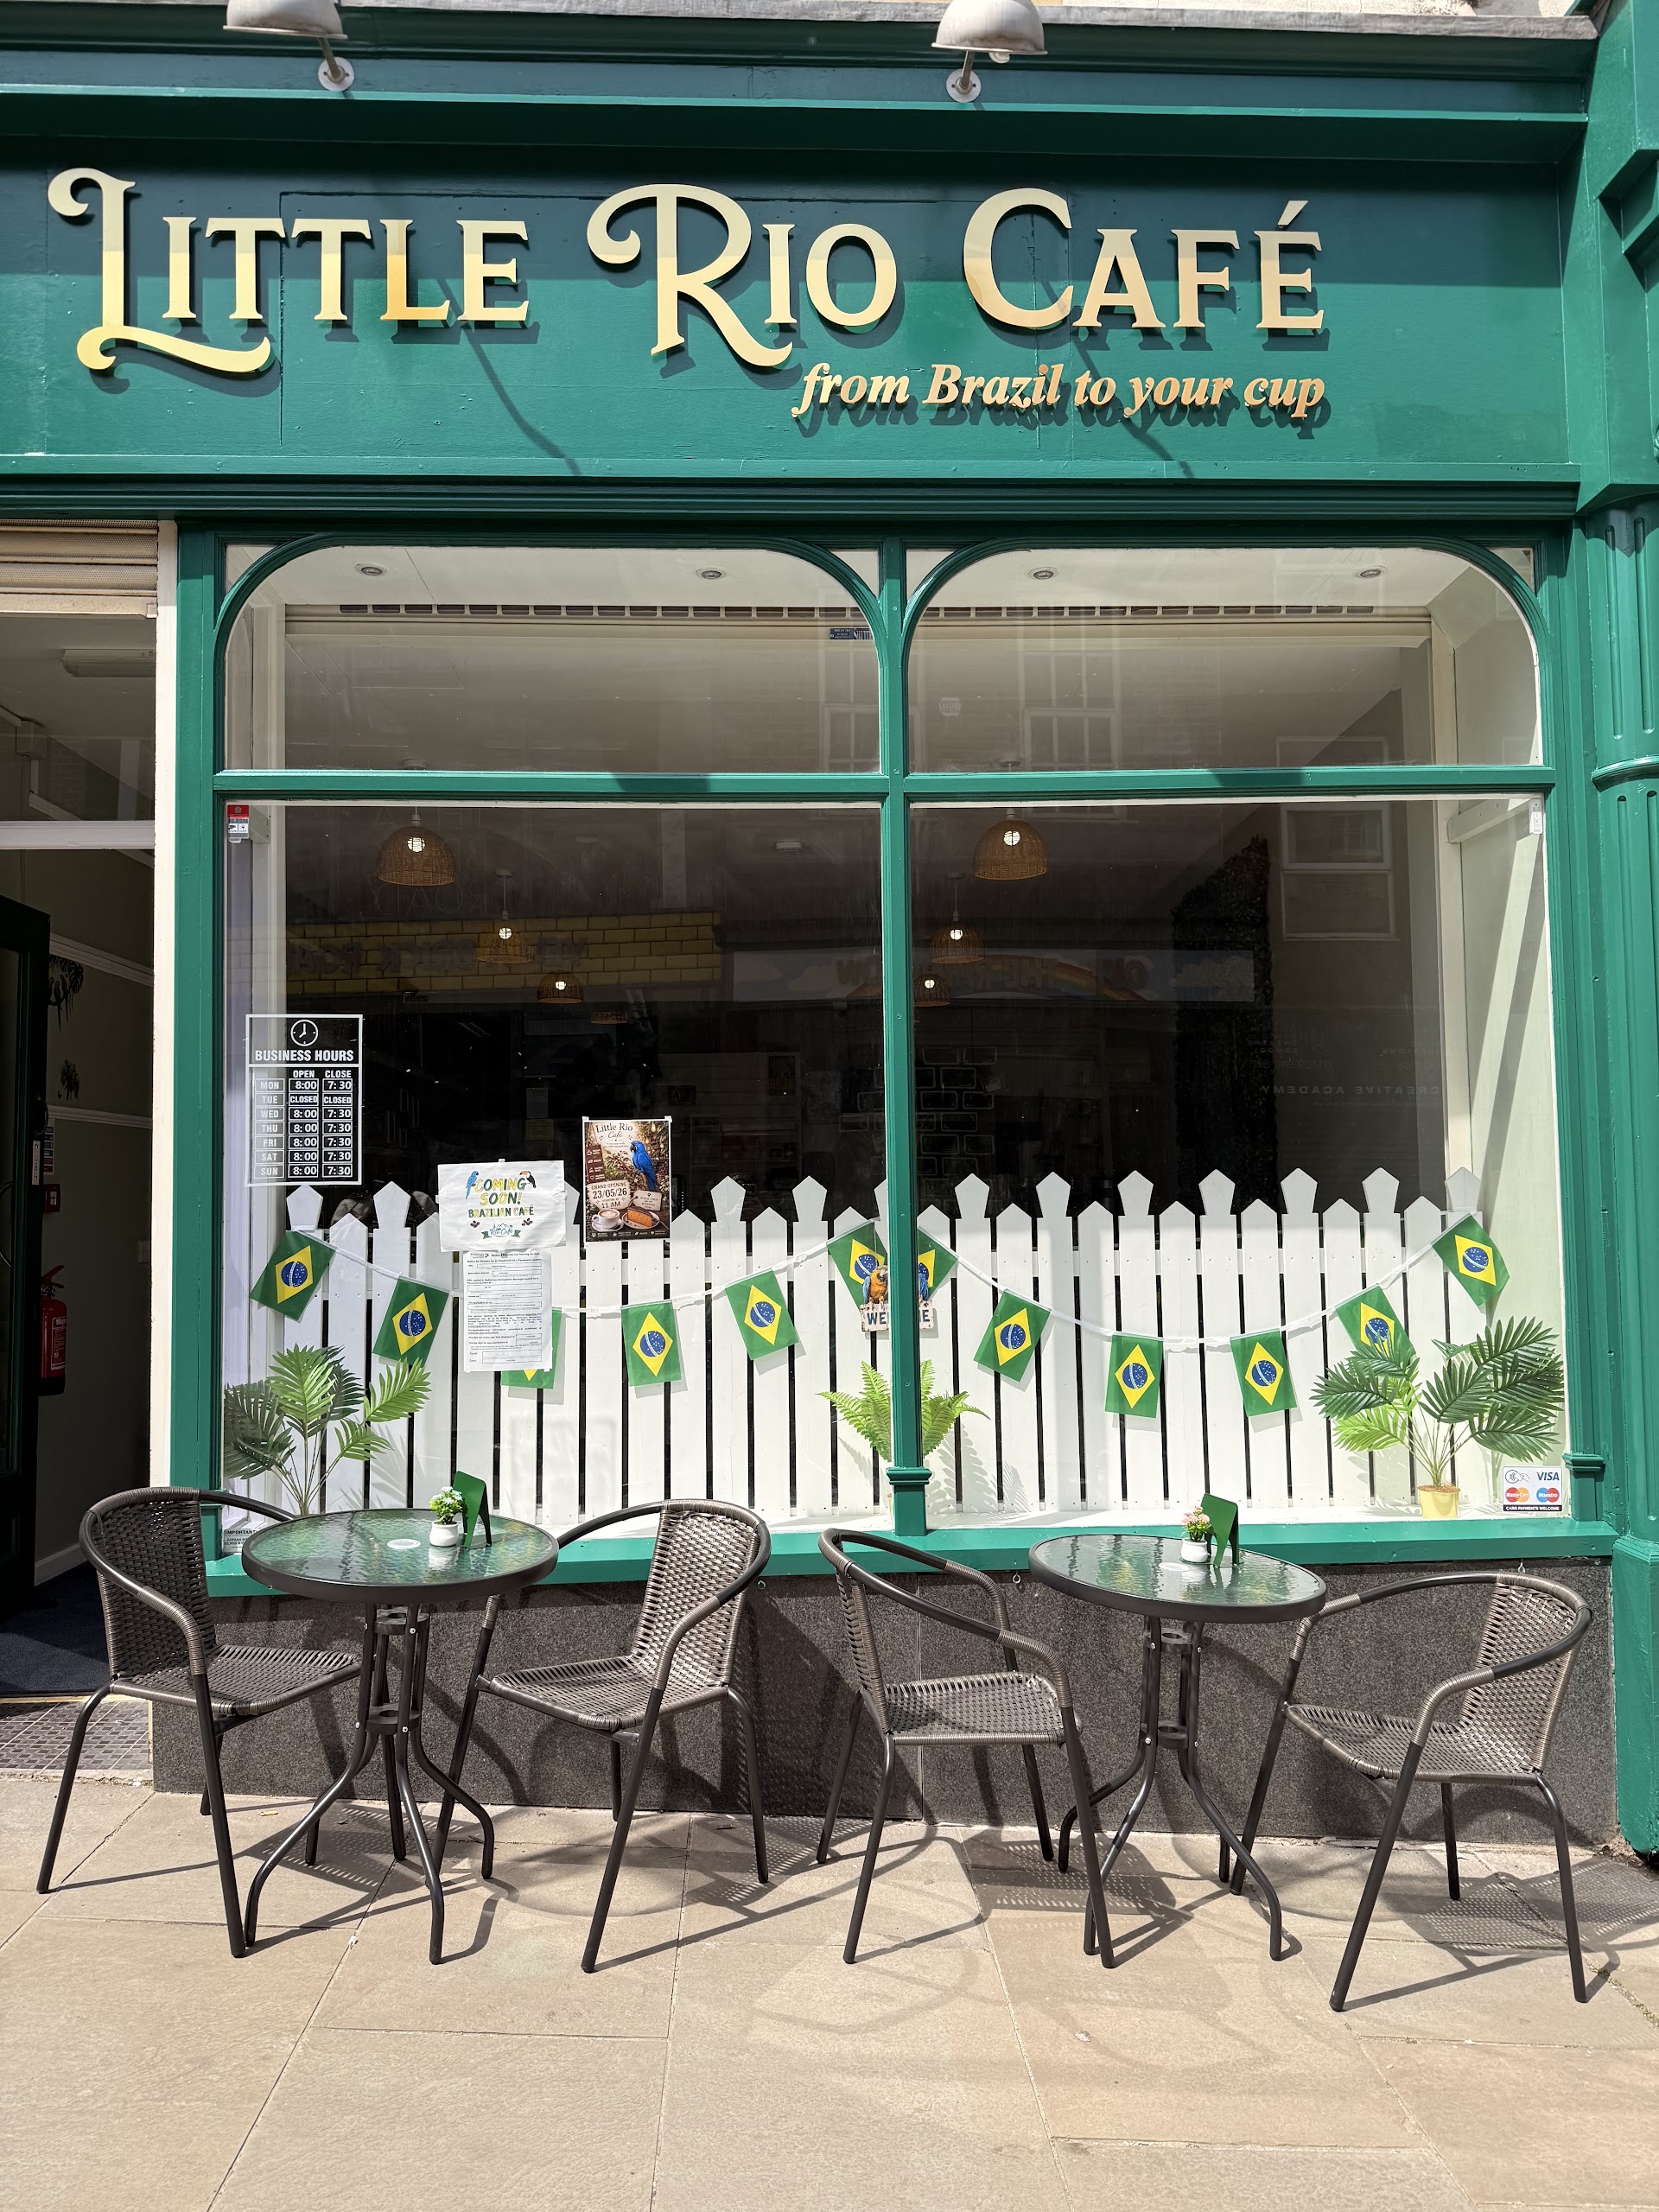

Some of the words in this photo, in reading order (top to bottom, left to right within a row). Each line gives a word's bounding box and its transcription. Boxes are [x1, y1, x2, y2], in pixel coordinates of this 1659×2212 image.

[963, 188, 1325, 334] CAFÉ
[791, 362, 910, 419] from
[922, 363, 1063, 410] Brazil
[1074, 369, 1117, 407] to
[1123, 375, 1234, 419] your
[1243, 375, 1325, 419] cup
[255, 1050, 312, 1062] BUSINESS
[315, 1050, 354, 1061] HOURS
[260, 1081, 279, 1090] MON
[295, 1080, 318, 1090] 8:00
[262, 1124, 278, 1133] THU
[596, 1123, 617, 1133] Little
[620, 1122, 633, 1131] Rio
[261, 1167, 278, 1176] SUN
[474, 1177, 527, 1192] COMING
[480, 1192, 522, 1206] SOON!
[593, 1187, 627, 1199] 23/05/26
[468, 1207, 512, 1218] BRAZILIAN
[513, 1205, 534, 1217] CAFÉ
[1536, 1471, 1560, 1481] VISA
